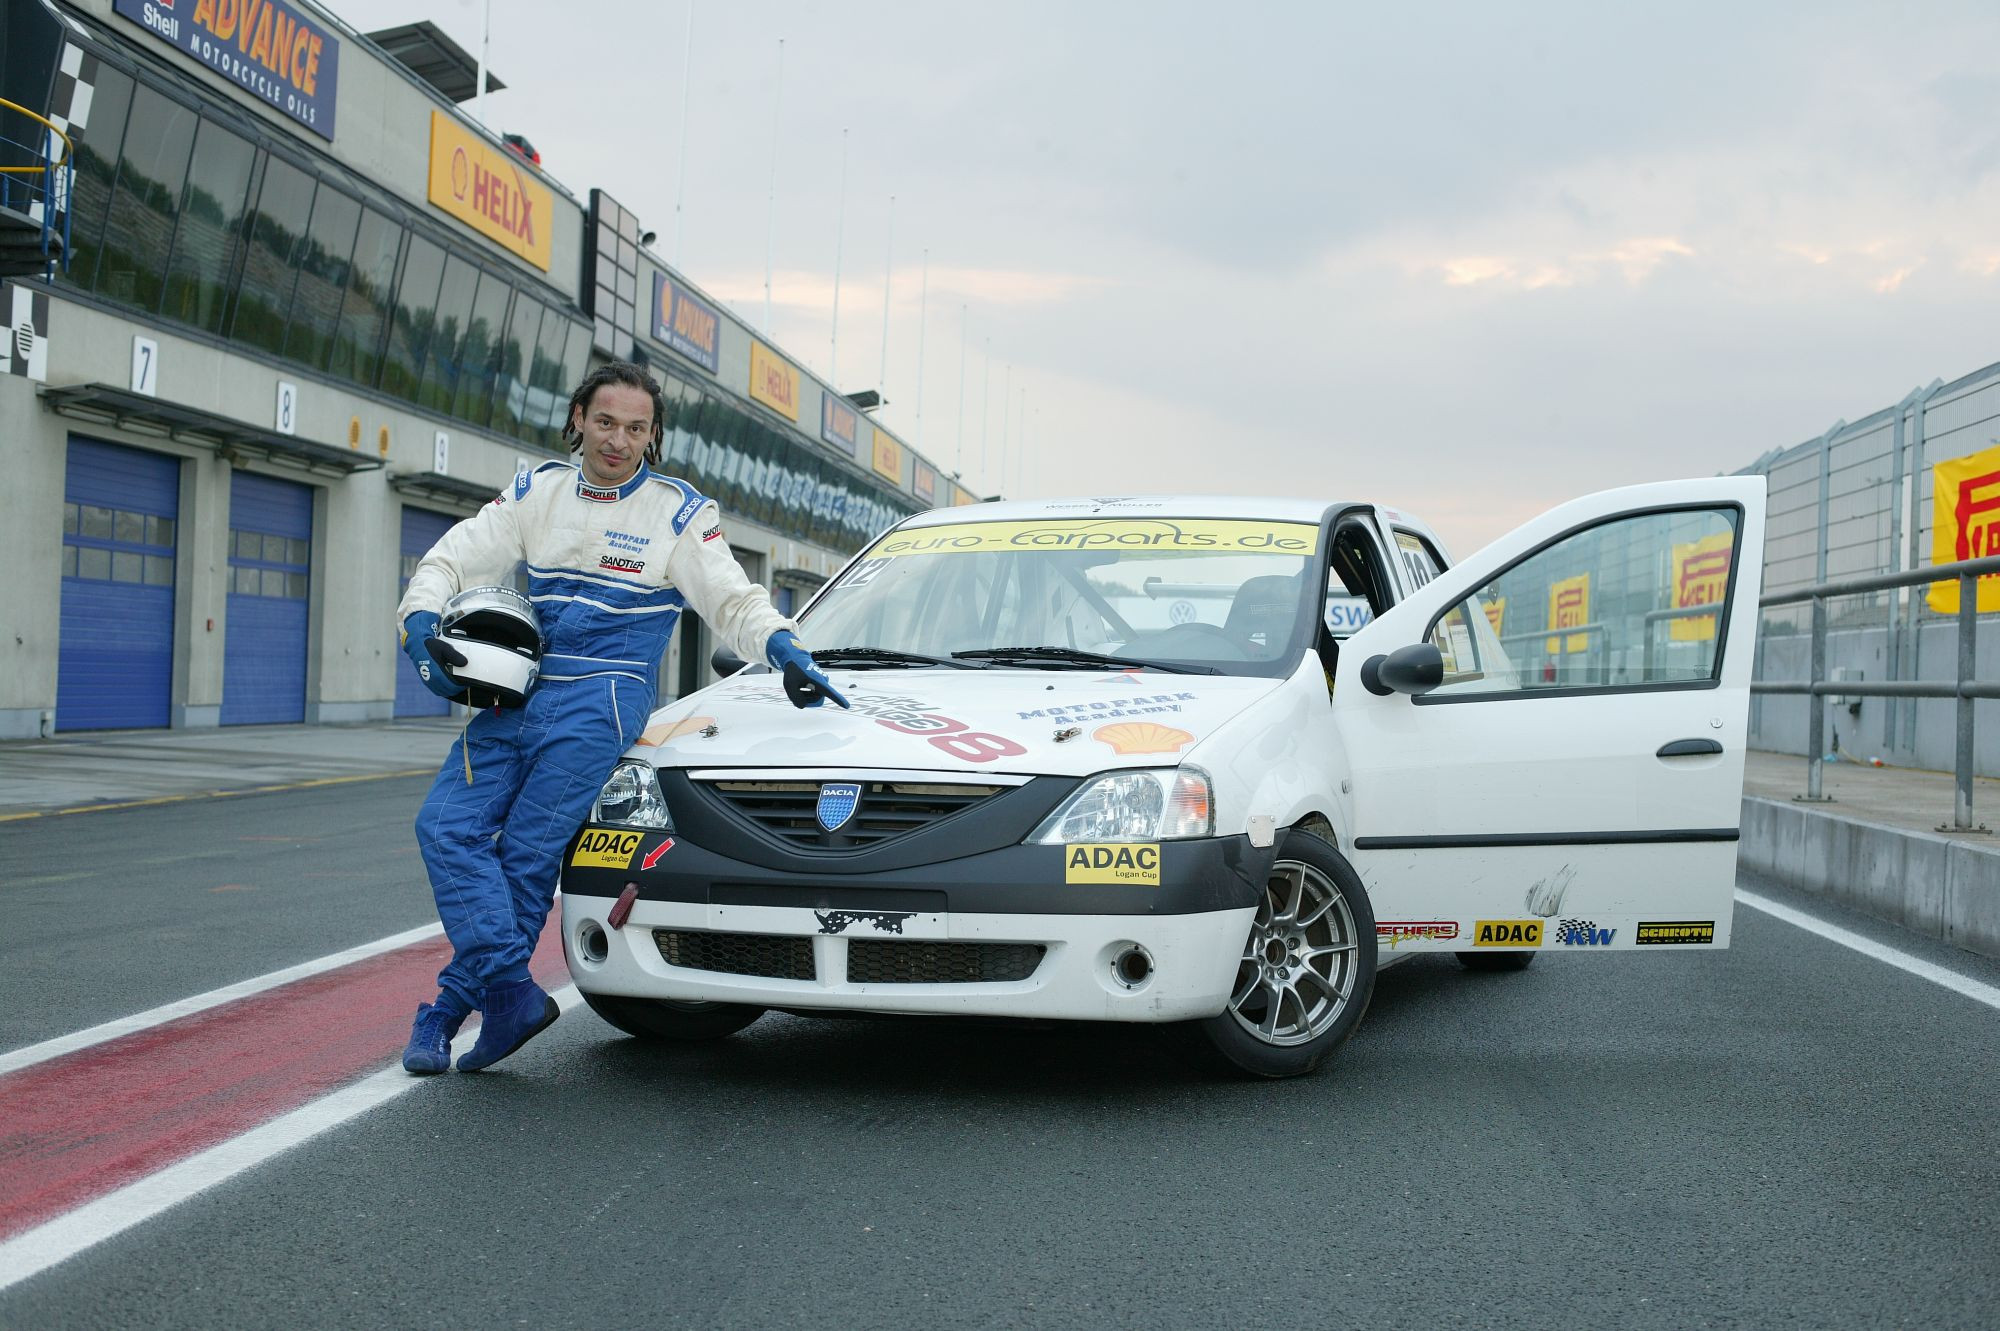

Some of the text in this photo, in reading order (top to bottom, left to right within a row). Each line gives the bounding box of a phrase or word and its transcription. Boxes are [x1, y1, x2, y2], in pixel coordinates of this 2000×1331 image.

[143, 3, 179, 40] Shell
[190, 34, 315, 124] MOTORCYCLE OILS
[472, 163, 534, 246] HELIX
[141, 346, 151, 389] 7
[282, 389, 291, 429] 8
[604, 530, 651, 546] MOTOPARK
[702, 524, 720, 538] SANDT
[883, 520, 1309, 553] euro-carparts.de
[608, 540, 643, 554] Academy
[600, 555, 646, 570] SANDTLER
[840, 557, 894, 587] 12
[1016, 692, 1199, 720] MOTOPARK
[1055, 704, 1182, 725] Academy
[577, 832, 639, 854] ADAC
[601, 854, 618, 862] Logan
[1069, 847, 1157, 870] ADAC
[1115, 870, 1157, 879] Logan Cup
[1376, 926, 1453, 935] IECHERS
[1479, 924, 1539, 943] ADAC
[1565, 928, 1617, 946] KW
[1638, 927, 1713, 938] SCHROTH
